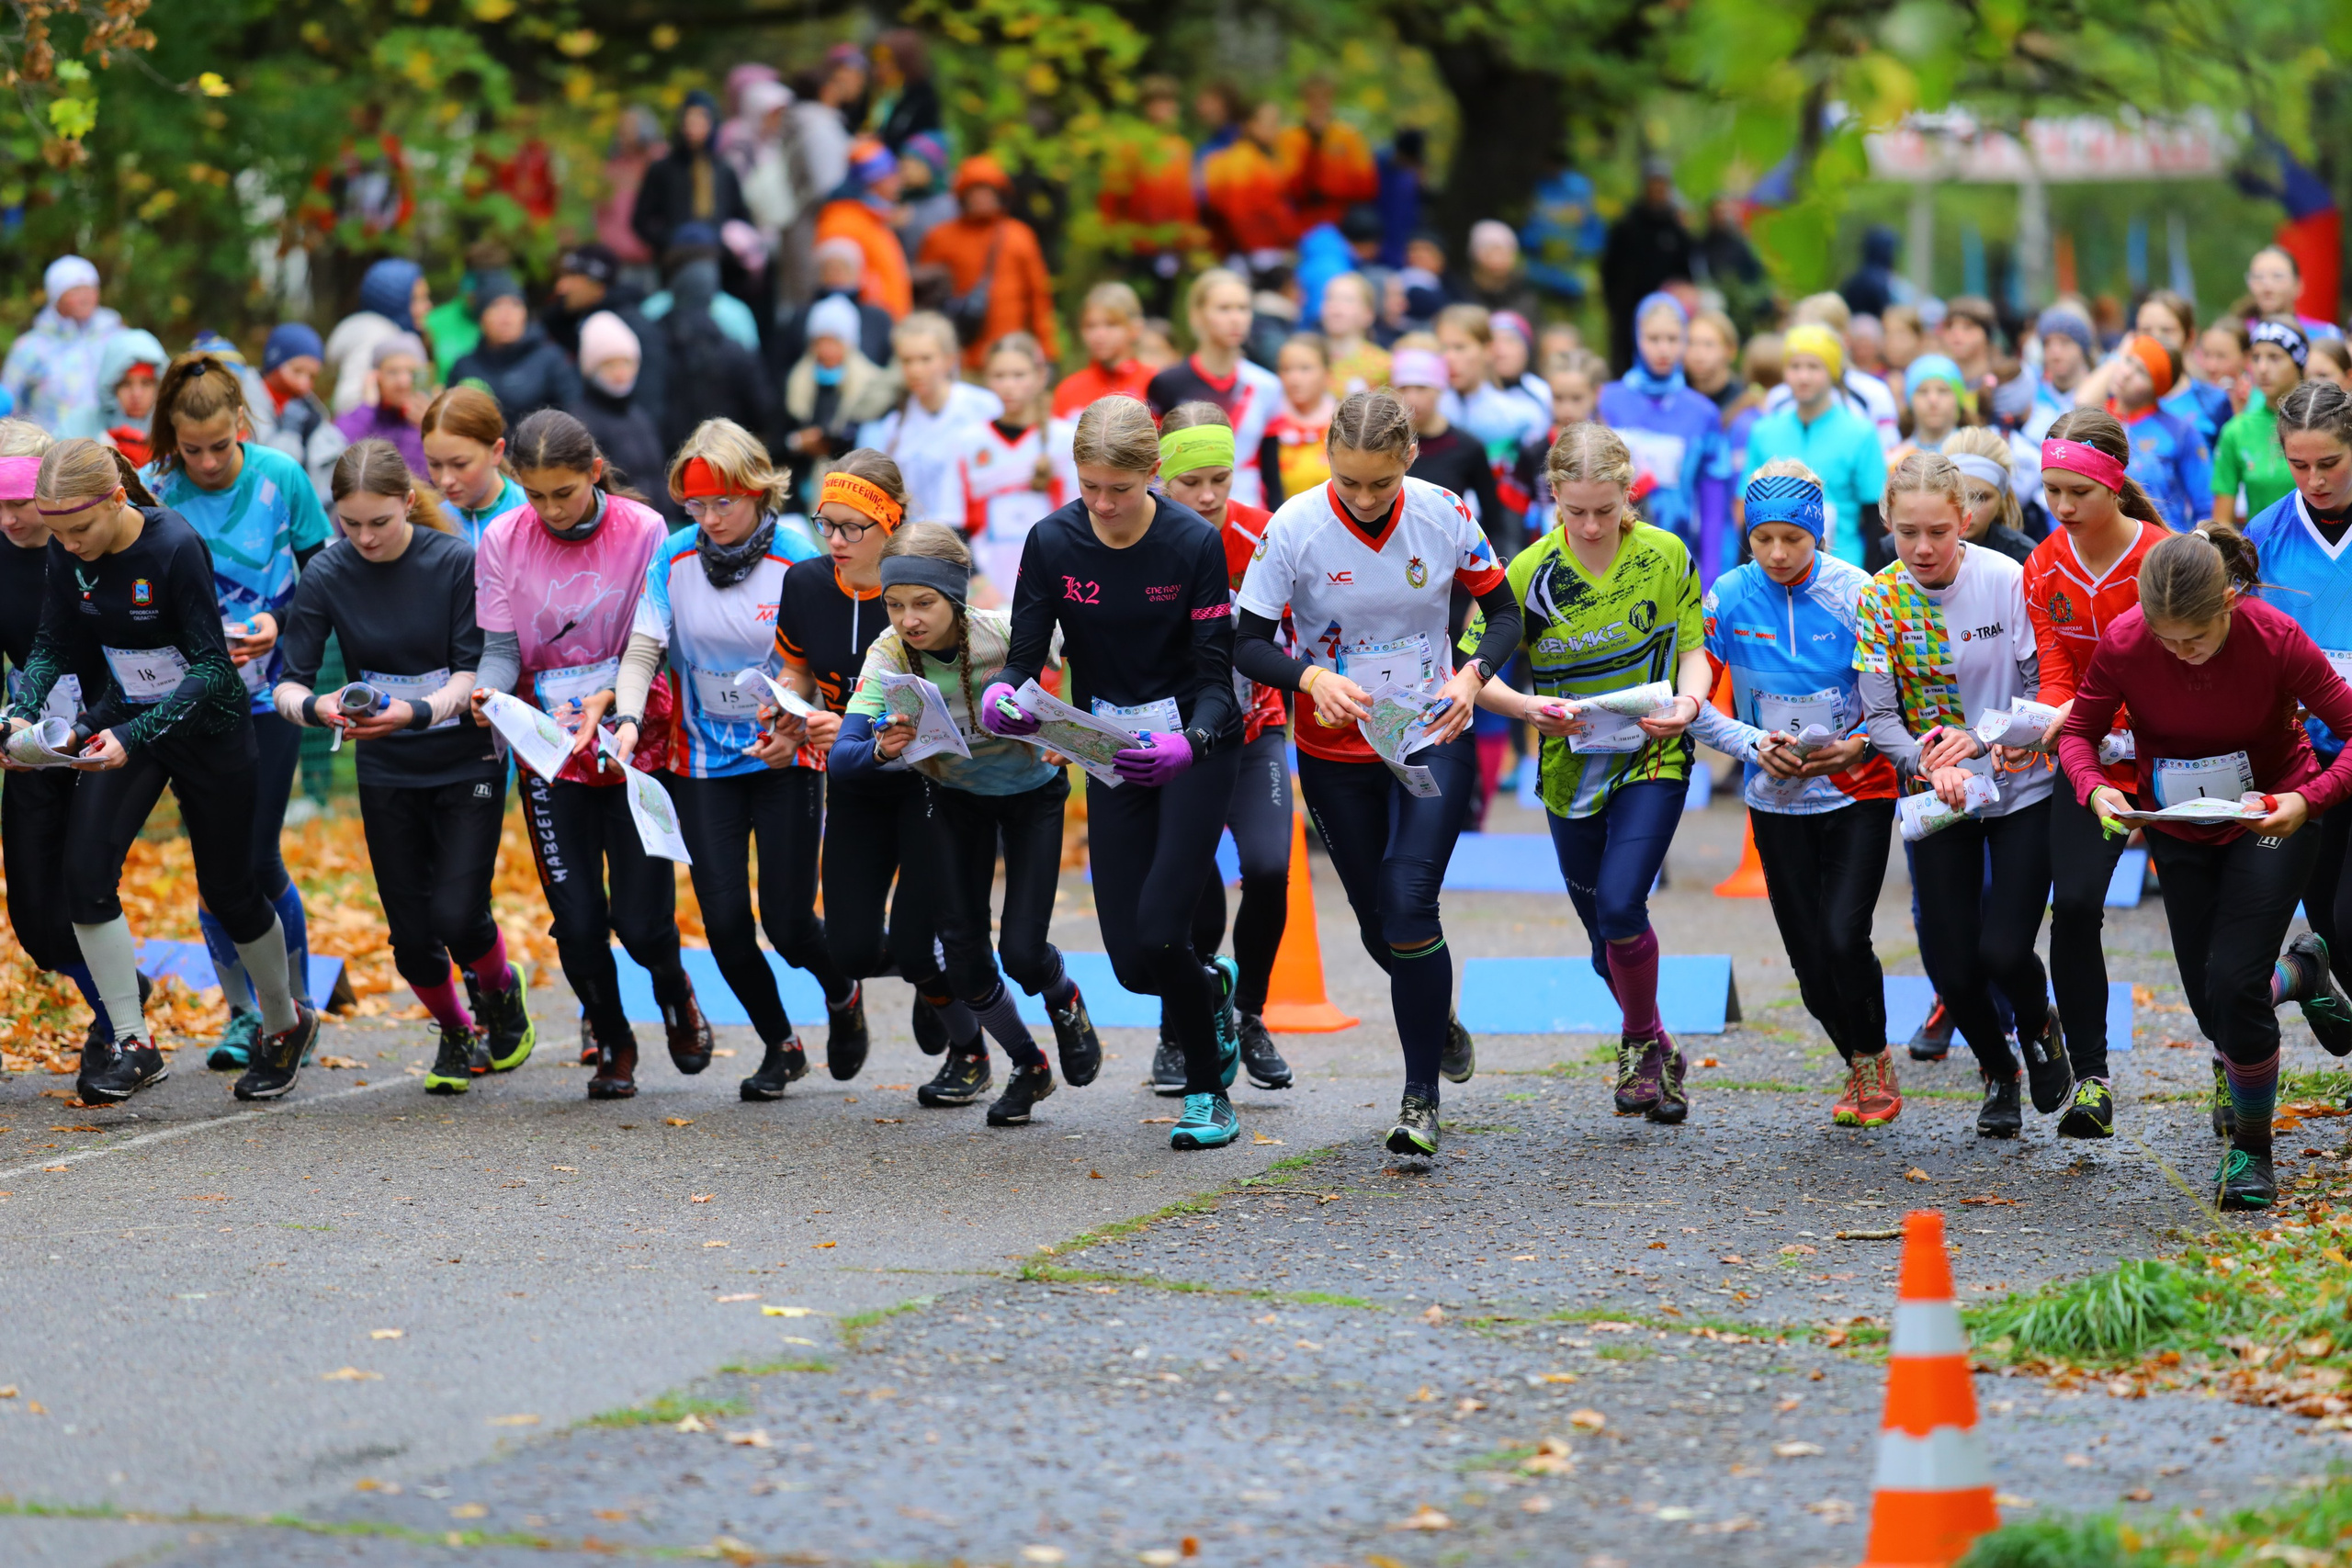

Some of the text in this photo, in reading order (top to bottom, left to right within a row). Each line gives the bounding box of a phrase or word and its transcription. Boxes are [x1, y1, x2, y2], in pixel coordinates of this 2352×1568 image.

[1145, 584, 1182, 595] ENERGY
[1148, 592, 1178, 603] GROUP
[1537, 620, 1627, 655] ФЕНИКС
[137, 668, 156, 682] 18
[1381, 670, 1392, 682] 7
[720, 690, 740, 704] 15
[1790, 718, 1801, 732] 5
[2198, 786, 2205, 798] 1
[530, 777, 568, 883] НАВСЕГДА
